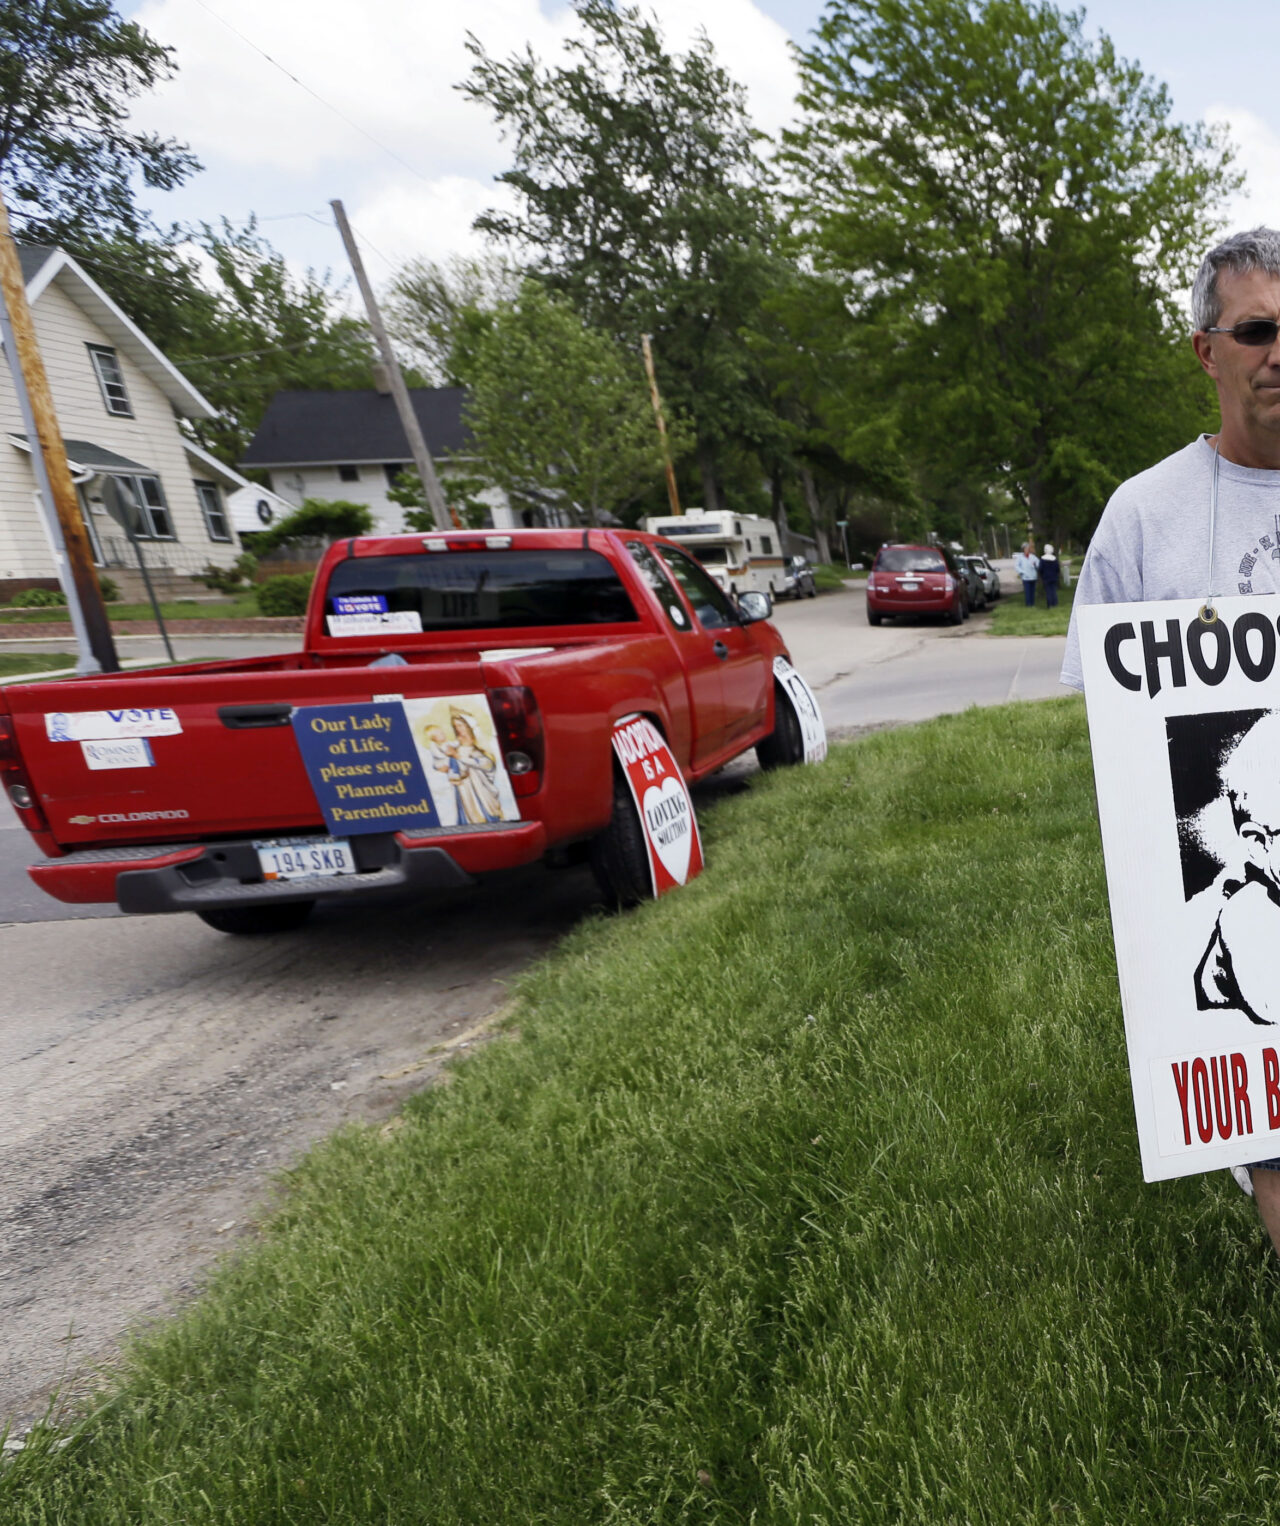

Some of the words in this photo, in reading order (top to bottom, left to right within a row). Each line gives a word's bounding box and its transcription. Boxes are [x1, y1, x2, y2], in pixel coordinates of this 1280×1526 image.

[106, 708, 174, 723] VOTE
[310, 717, 347, 733] Our
[350, 713, 392, 732] Lady
[329, 738, 348, 755] of
[350, 736, 390, 754] Life,
[319, 762, 373, 783] please
[376, 760, 412, 776] stop
[641, 760, 656, 781] IS
[653, 755, 666, 775] A
[335, 779, 407, 799] Planned
[97, 809, 190, 823] COLORADO
[330, 799, 430, 821] Parenthood
[647, 792, 687, 831] LOVING
[272, 851, 305, 873] 194
[310, 849, 347, 870] SKB
[1171, 1052, 1254, 1146] YOUR
